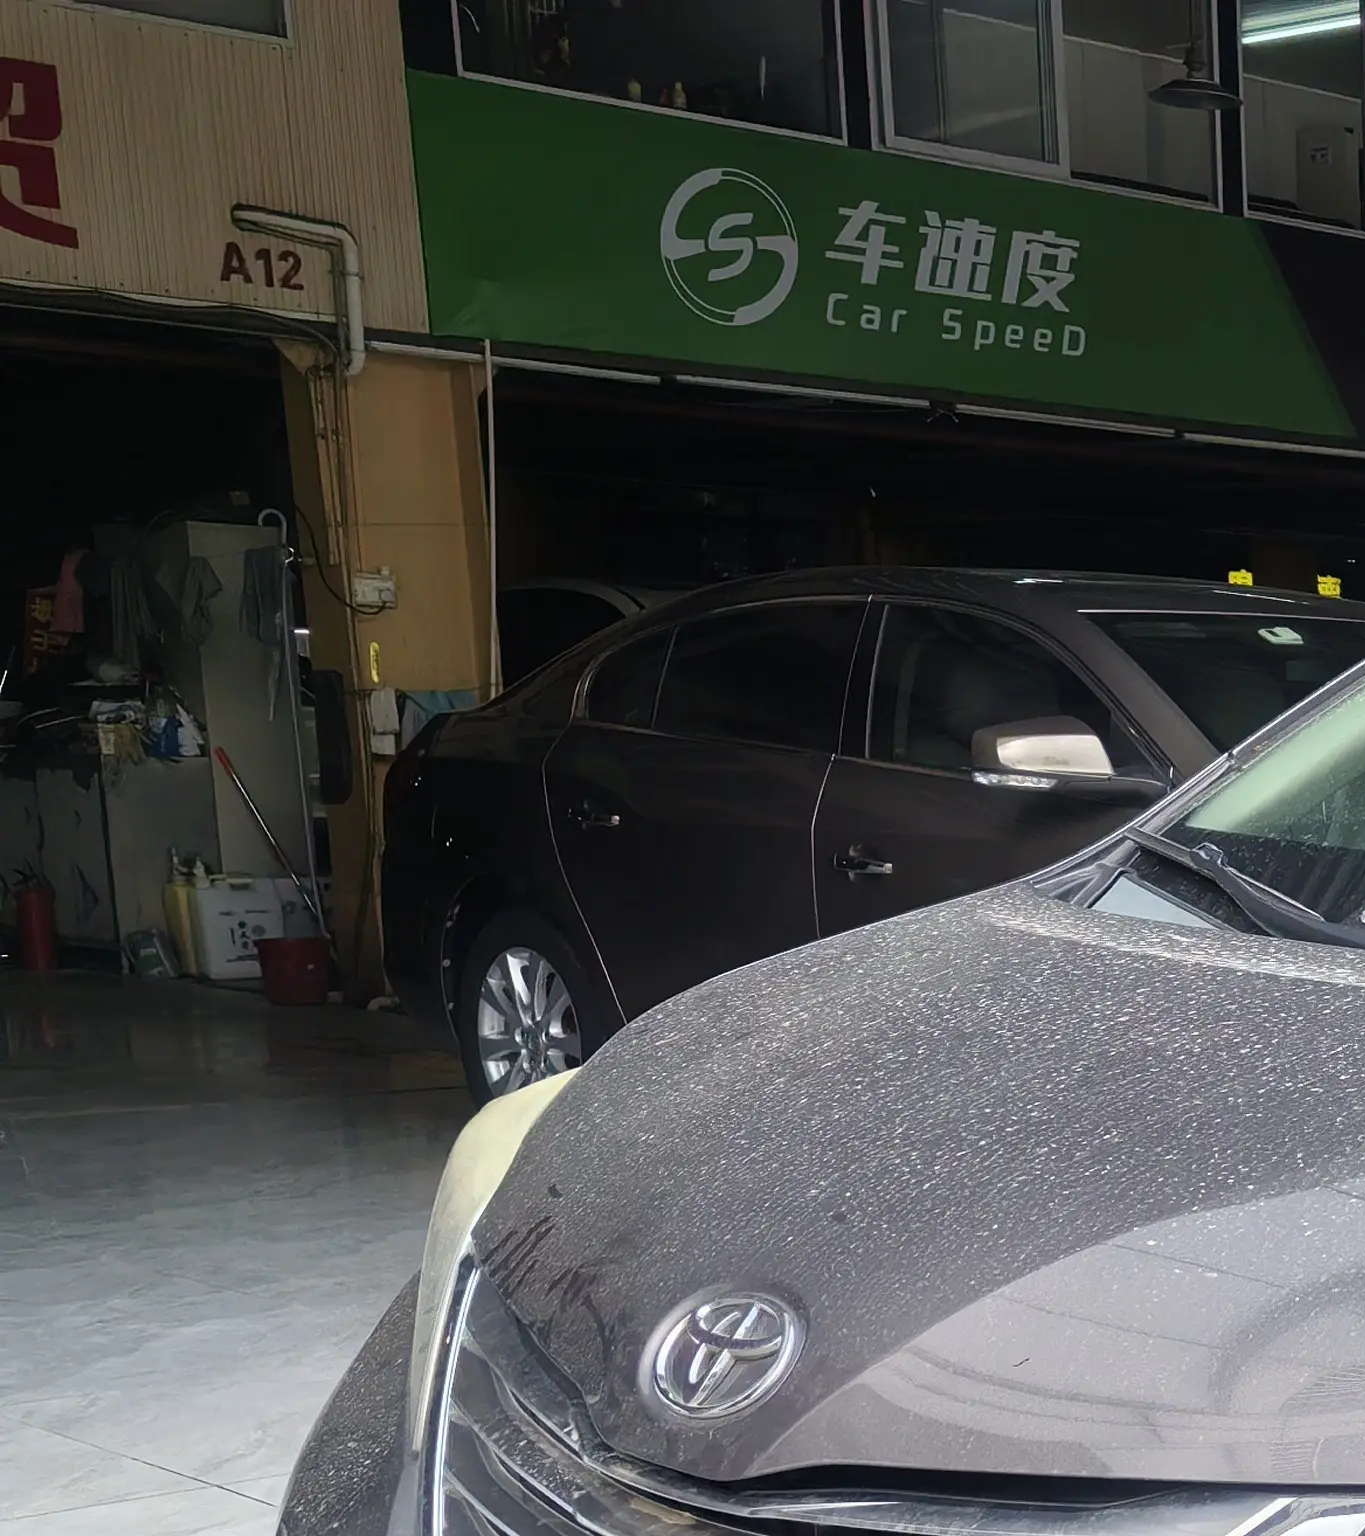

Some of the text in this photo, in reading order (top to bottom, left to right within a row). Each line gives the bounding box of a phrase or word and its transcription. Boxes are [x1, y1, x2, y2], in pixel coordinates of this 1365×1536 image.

[219, 242, 305, 291] A12
[826, 200, 1080, 313] 车速度
[826, 292, 908, 335] Car
